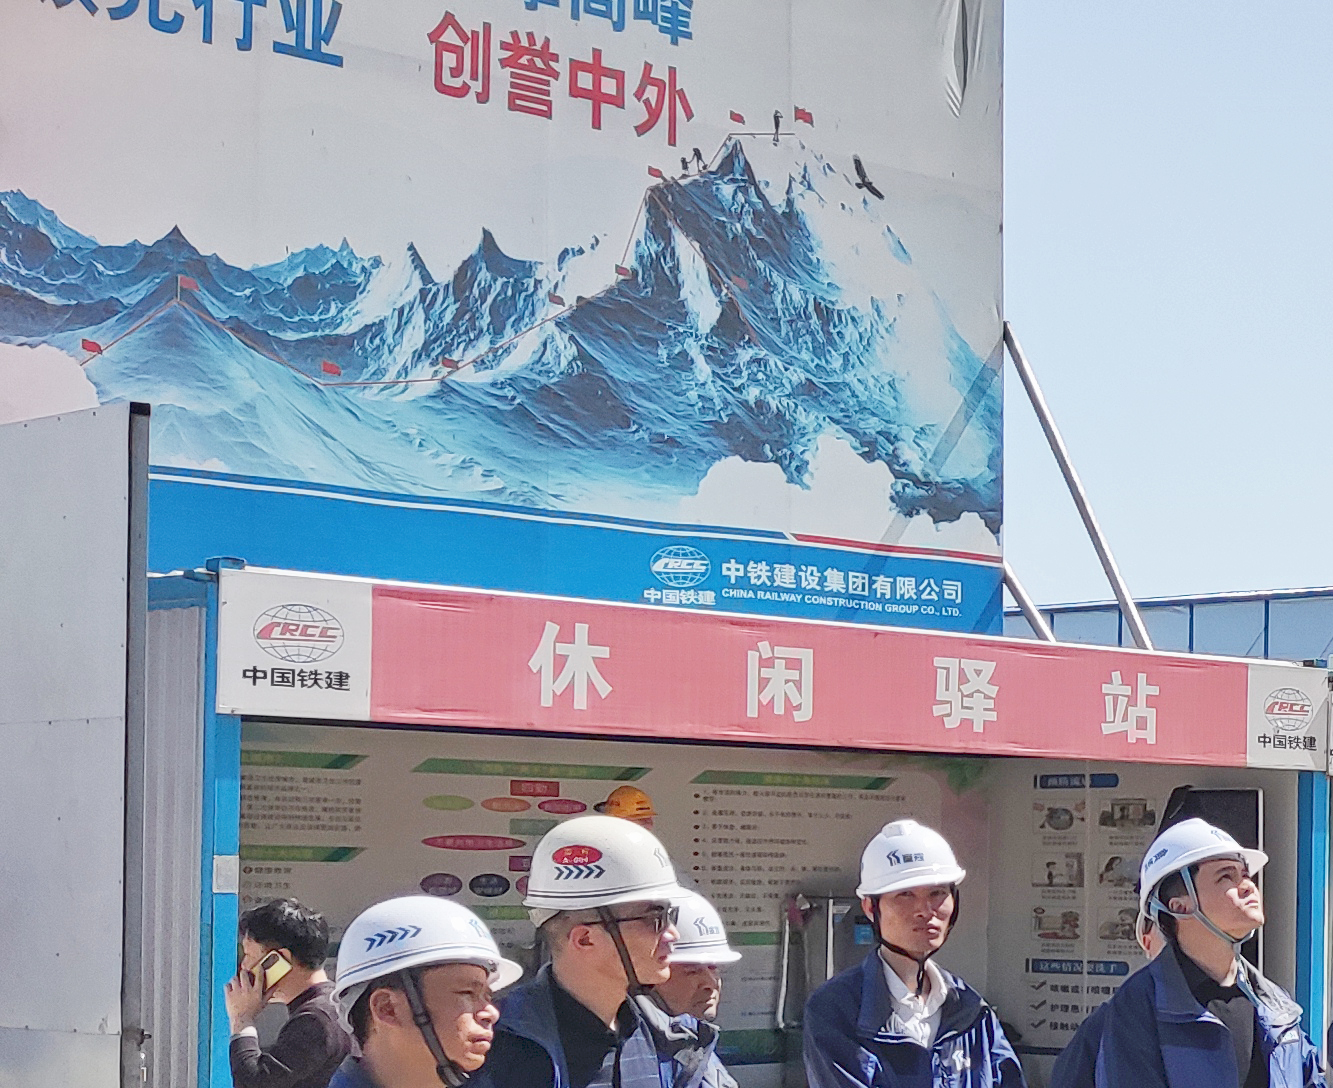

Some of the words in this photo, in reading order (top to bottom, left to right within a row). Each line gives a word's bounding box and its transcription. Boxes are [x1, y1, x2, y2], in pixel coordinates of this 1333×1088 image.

[426, 10, 695, 147] 创誉中外
[721, 558, 963, 605] 中铁建设集团有限公司
[643, 588, 717, 606] 中国铁建
[721, 588, 756, 600] CHINA
[757, 591, 802, 603] RAILWAY
[804, 594, 883, 612] CONSTRUCTION
[884, 604, 919, 614] GROUP
[941, 607, 962, 617] LTD.
[241, 665, 351, 691] 中国铁建
[527, 620, 1160, 745] 休闲驿站
[1257, 733, 1318, 751] 中国铁建
